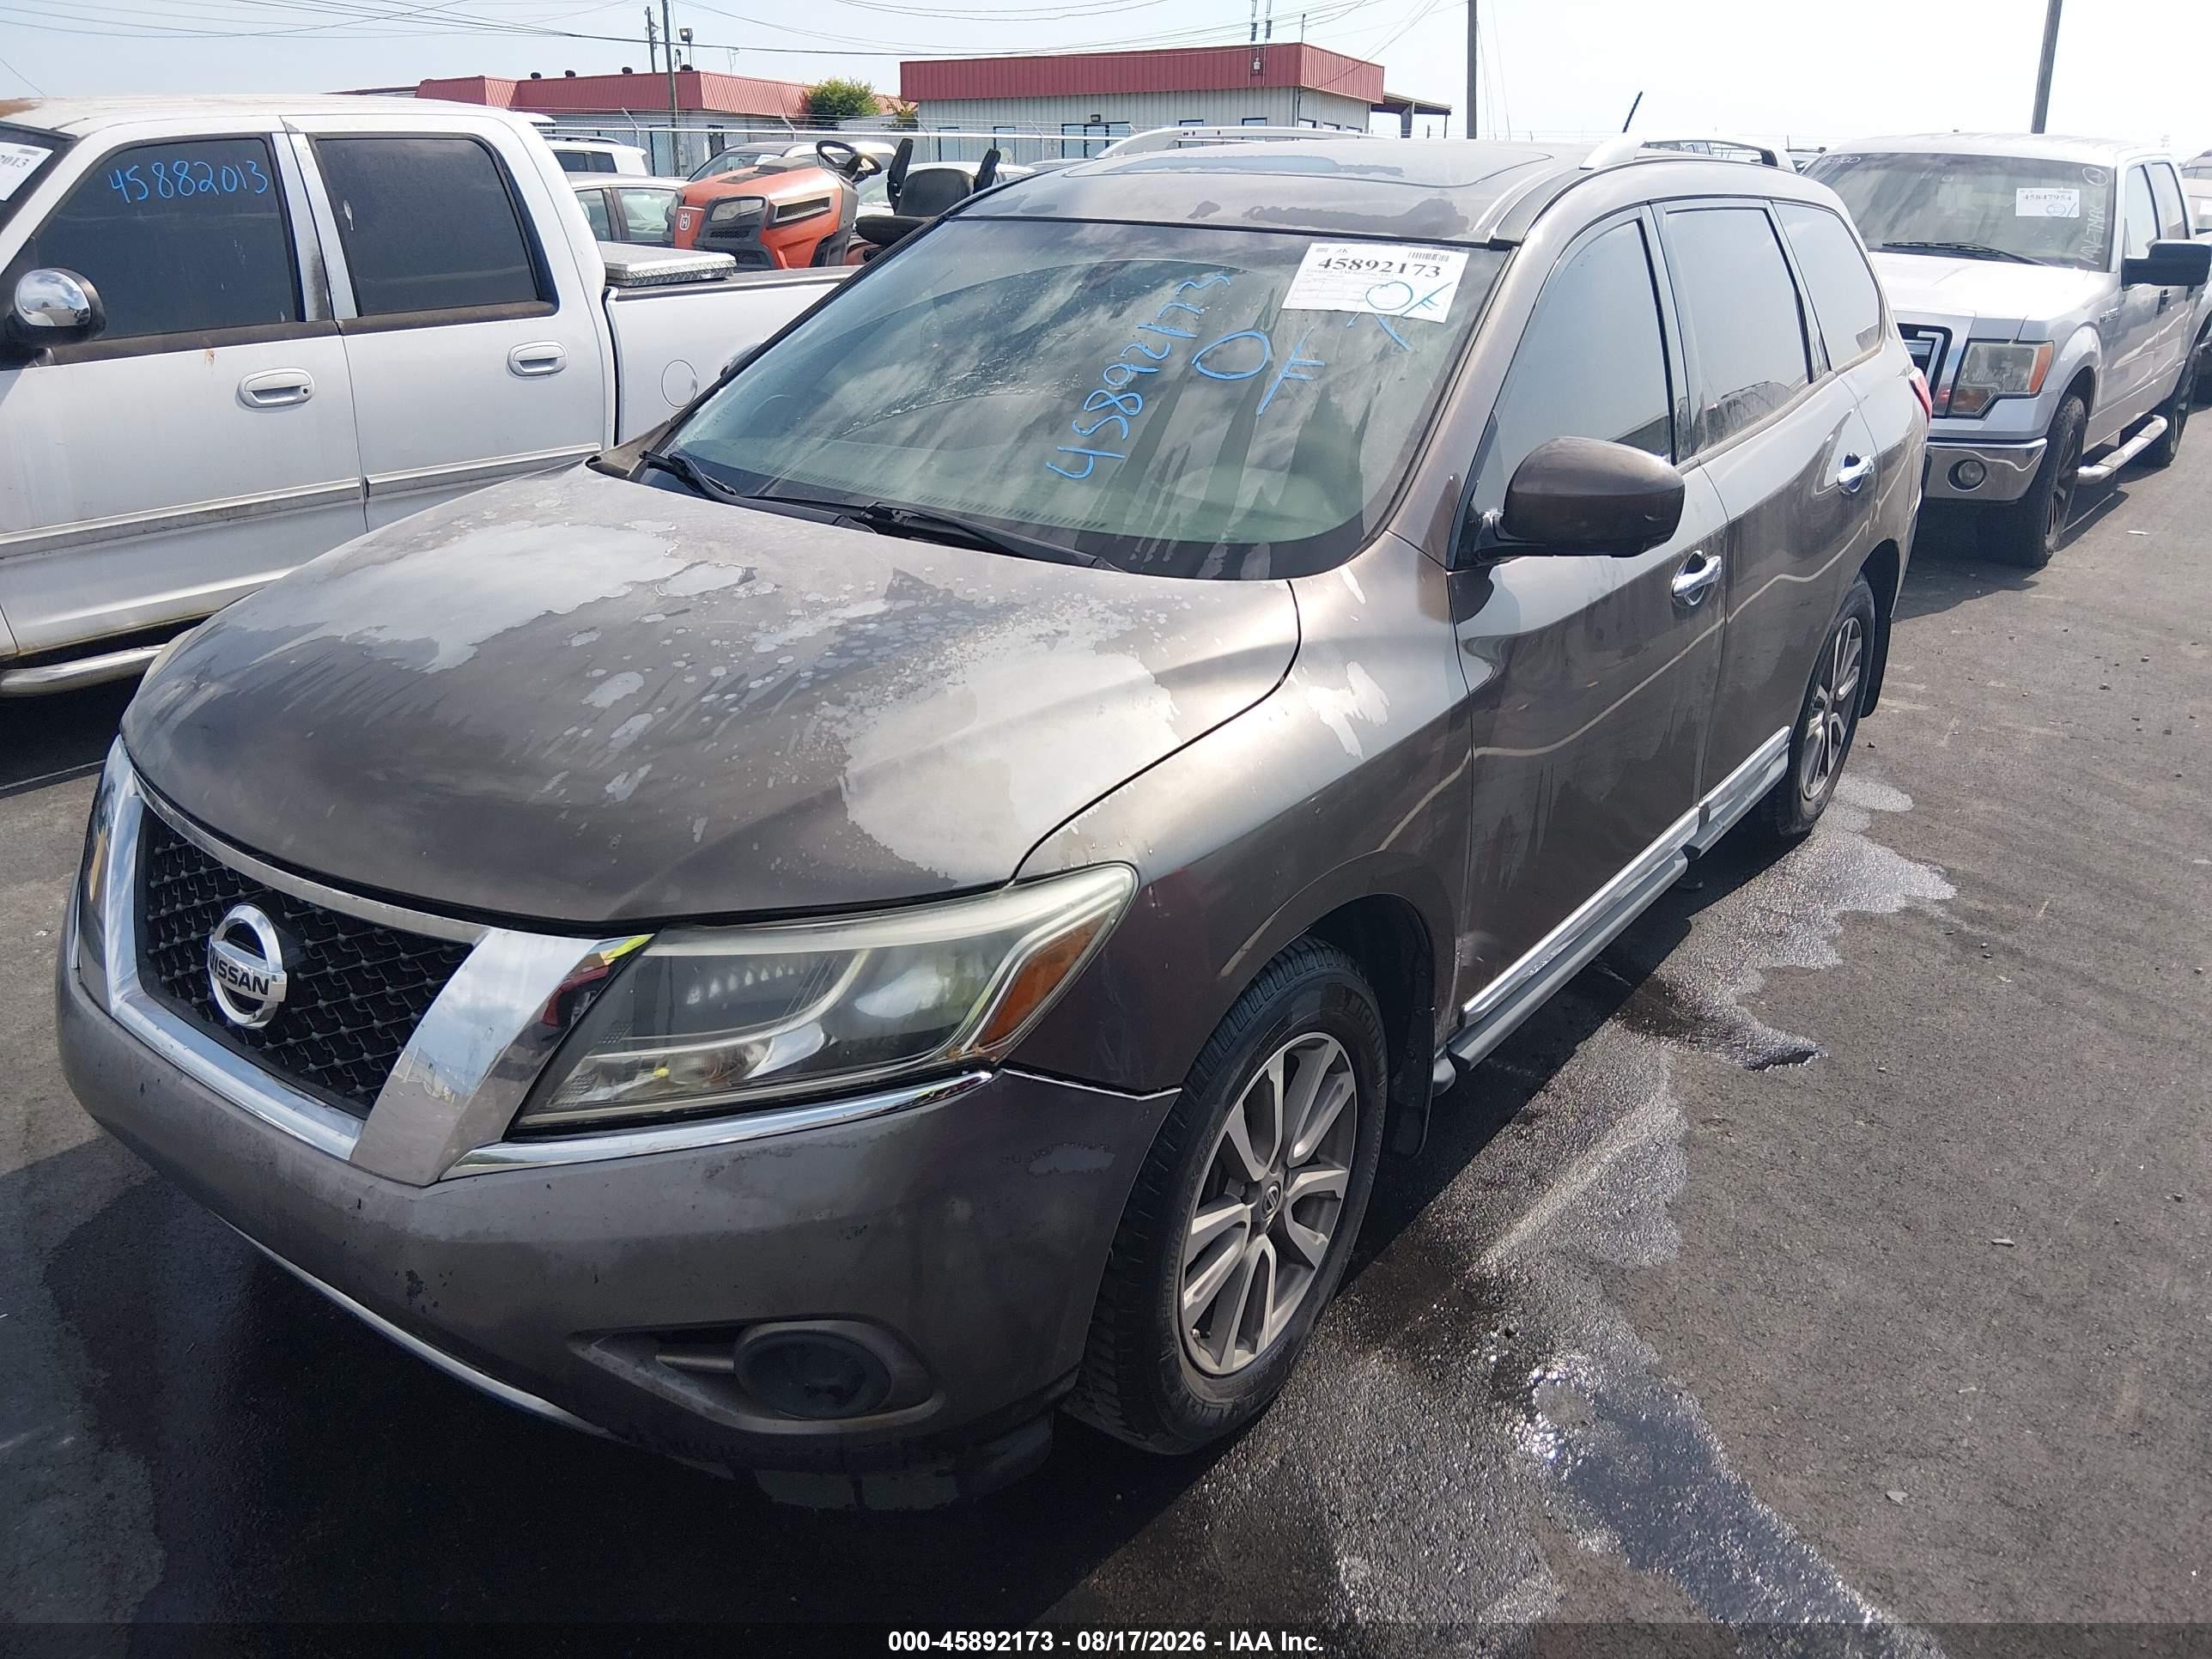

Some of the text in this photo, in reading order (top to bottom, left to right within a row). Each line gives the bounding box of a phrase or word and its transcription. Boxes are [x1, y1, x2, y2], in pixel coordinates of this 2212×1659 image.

[108, 160, 268, 204] 45882013
[1317, 258, 1442, 279] 45892173
[1045, 274, 1231, 479] 45892173
[209, 951, 270, 996] NISSAN
